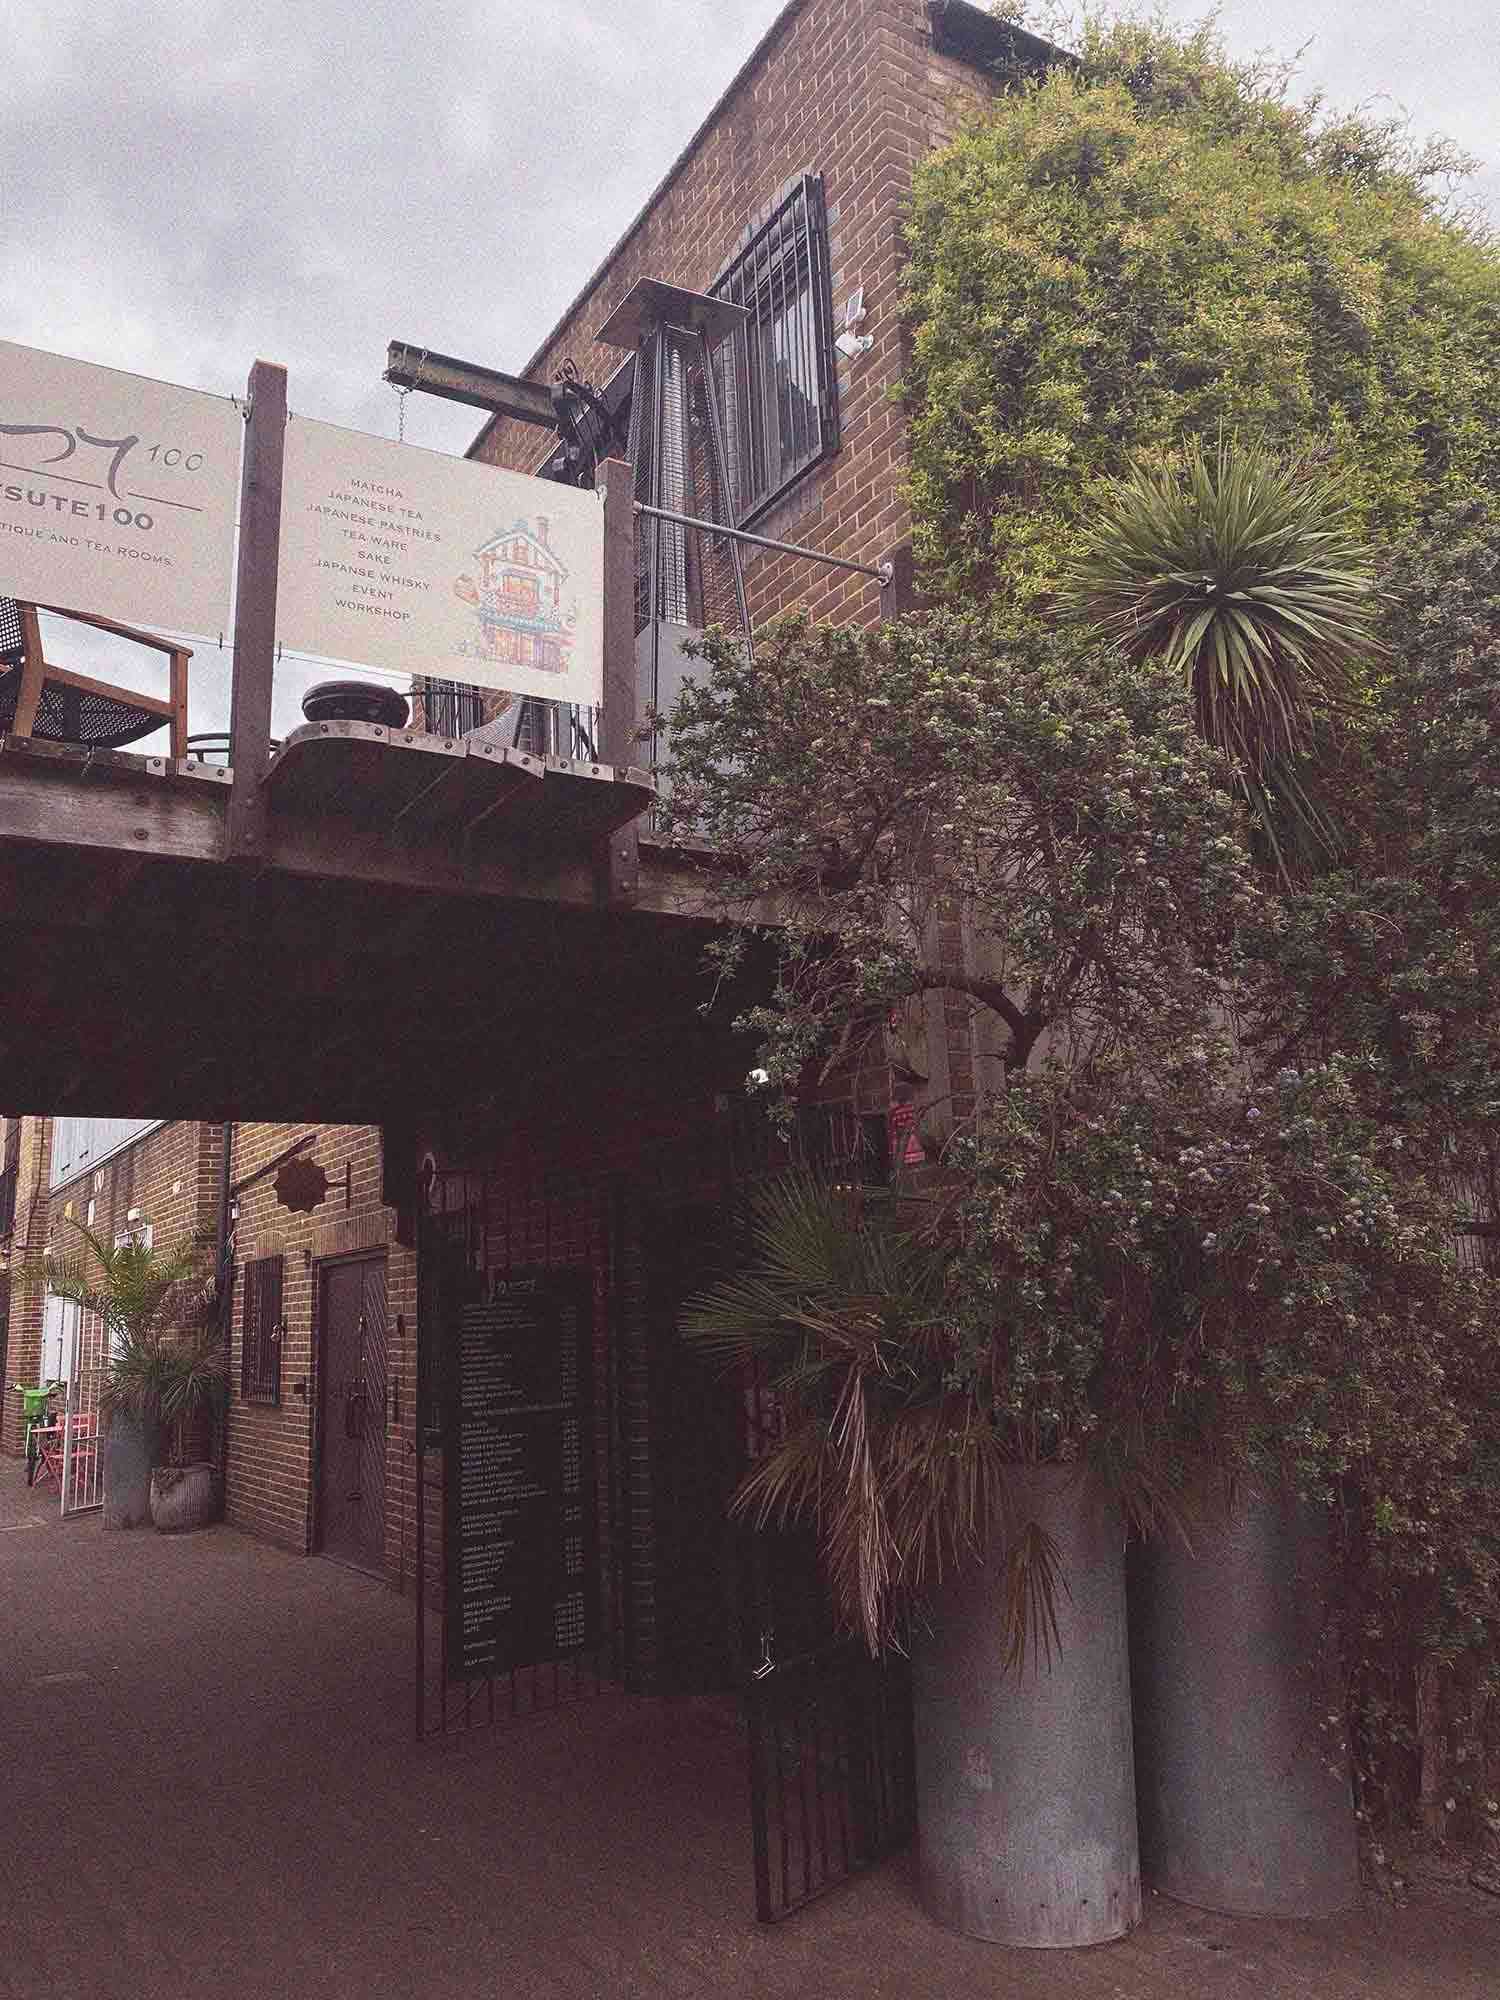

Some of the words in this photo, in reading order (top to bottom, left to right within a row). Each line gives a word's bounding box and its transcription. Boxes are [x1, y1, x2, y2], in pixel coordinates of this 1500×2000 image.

[147, 443, 203, 471] 100
[351, 479, 403, 498] MATCHA
[0, 484, 154, 531] SUTE100
[328, 490, 394, 513] JAPANESE
[400, 507, 423, 520] TEA
[306, 503, 376, 526] JAPANESE
[380, 520, 441, 542] PASTRIES
[50, 533, 79, 546] AND
[86, 540, 111, 553] TEA
[117, 547, 174, 567] ROOMS
[342, 528, 366, 542] TEA
[371, 536, 408, 551] WARE
[358, 551, 392, 565] SAKE
[316, 560, 375, 578] JAPANSE
[380, 573, 431, 591] WHISKY
[352, 584, 393, 601] EVENT
[335, 599, 411, 621] WORKSHOP
